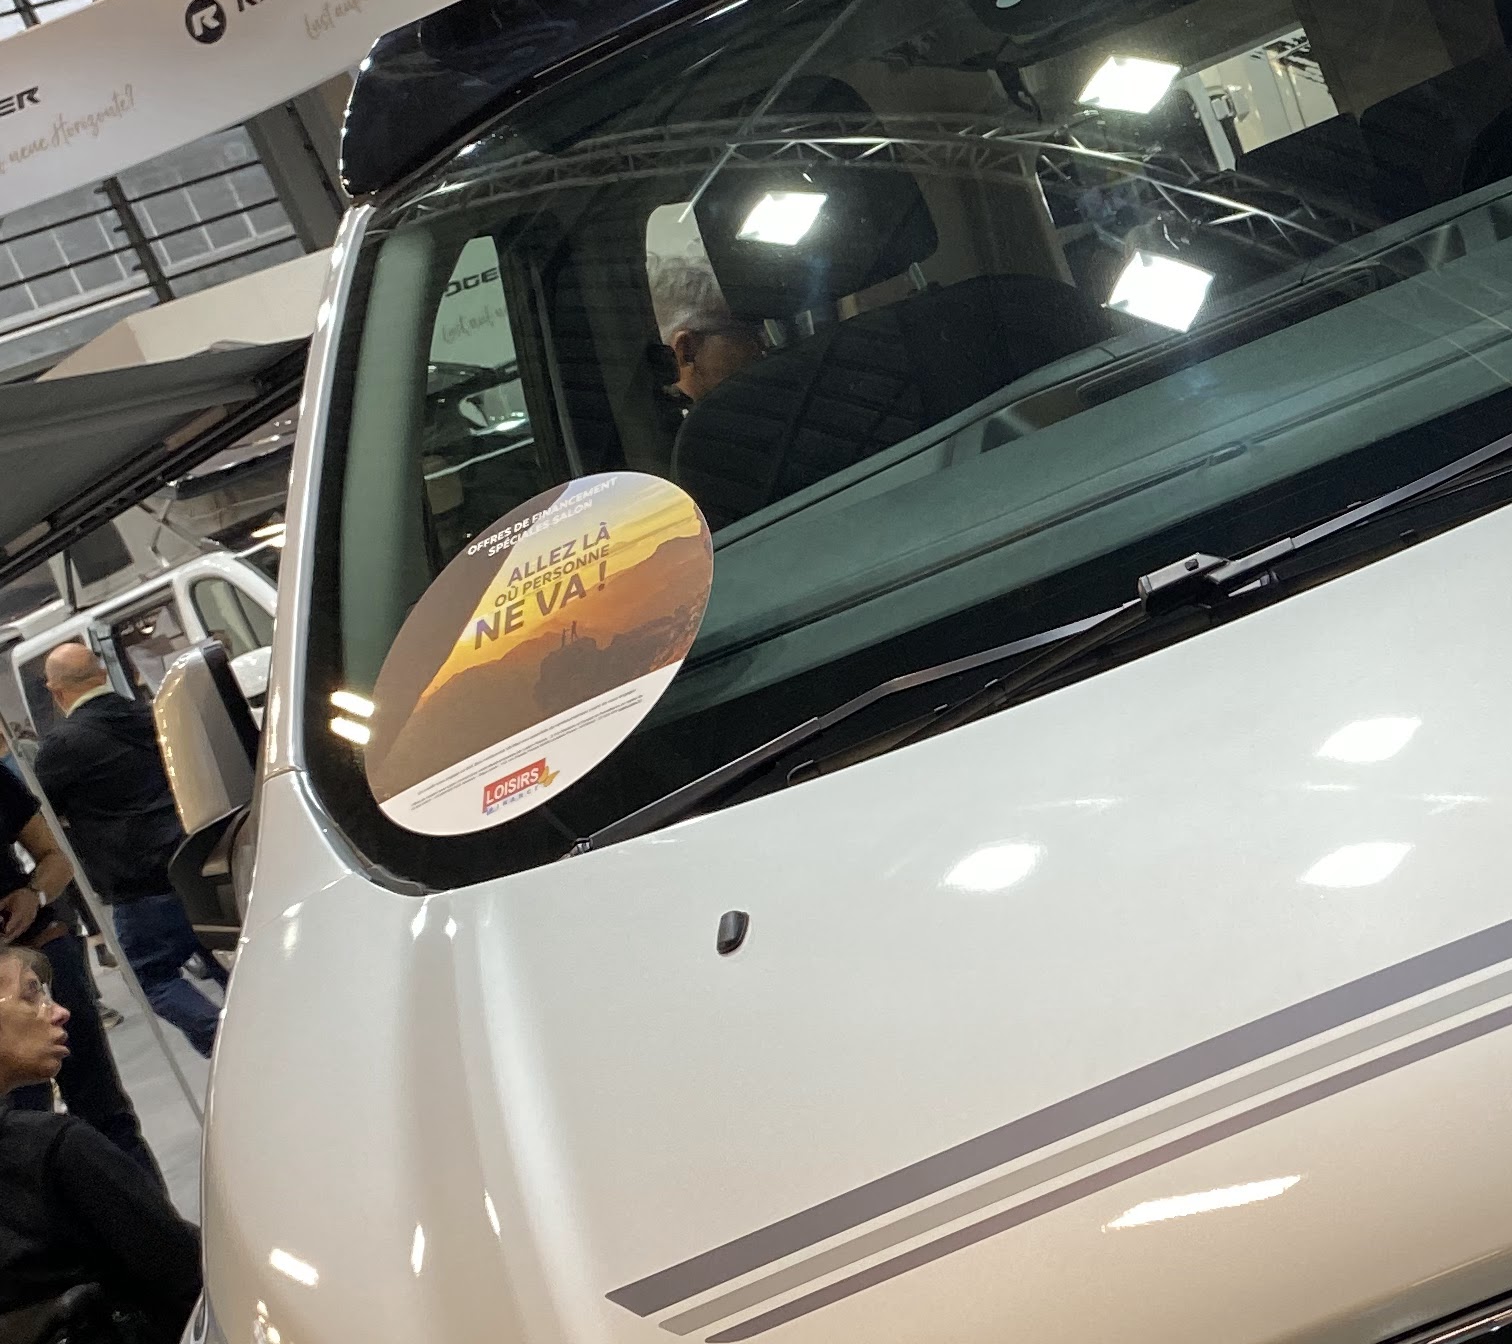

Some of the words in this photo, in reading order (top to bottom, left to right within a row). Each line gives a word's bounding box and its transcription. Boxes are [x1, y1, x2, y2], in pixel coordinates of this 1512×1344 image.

[467, 526, 512, 557] OFFRES
[514, 517, 531, 533] DE
[532, 476, 618, 523] FINANCEMENT
[488, 520, 551, 557] SPÉCIALES
[552, 499, 594, 525] SALON
[494, 584, 519, 608] OÙ
[522, 543, 610, 596] PERSONNE
[507, 539, 577, 588] ALLEZ
[582, 521, 611, 550] LÀ
[474, 598, 525, 651] NE
[536, 573, 587, 617] VA
[598, 560, 607, 592] !
[486, 767, 540, 806] LOISIRS
